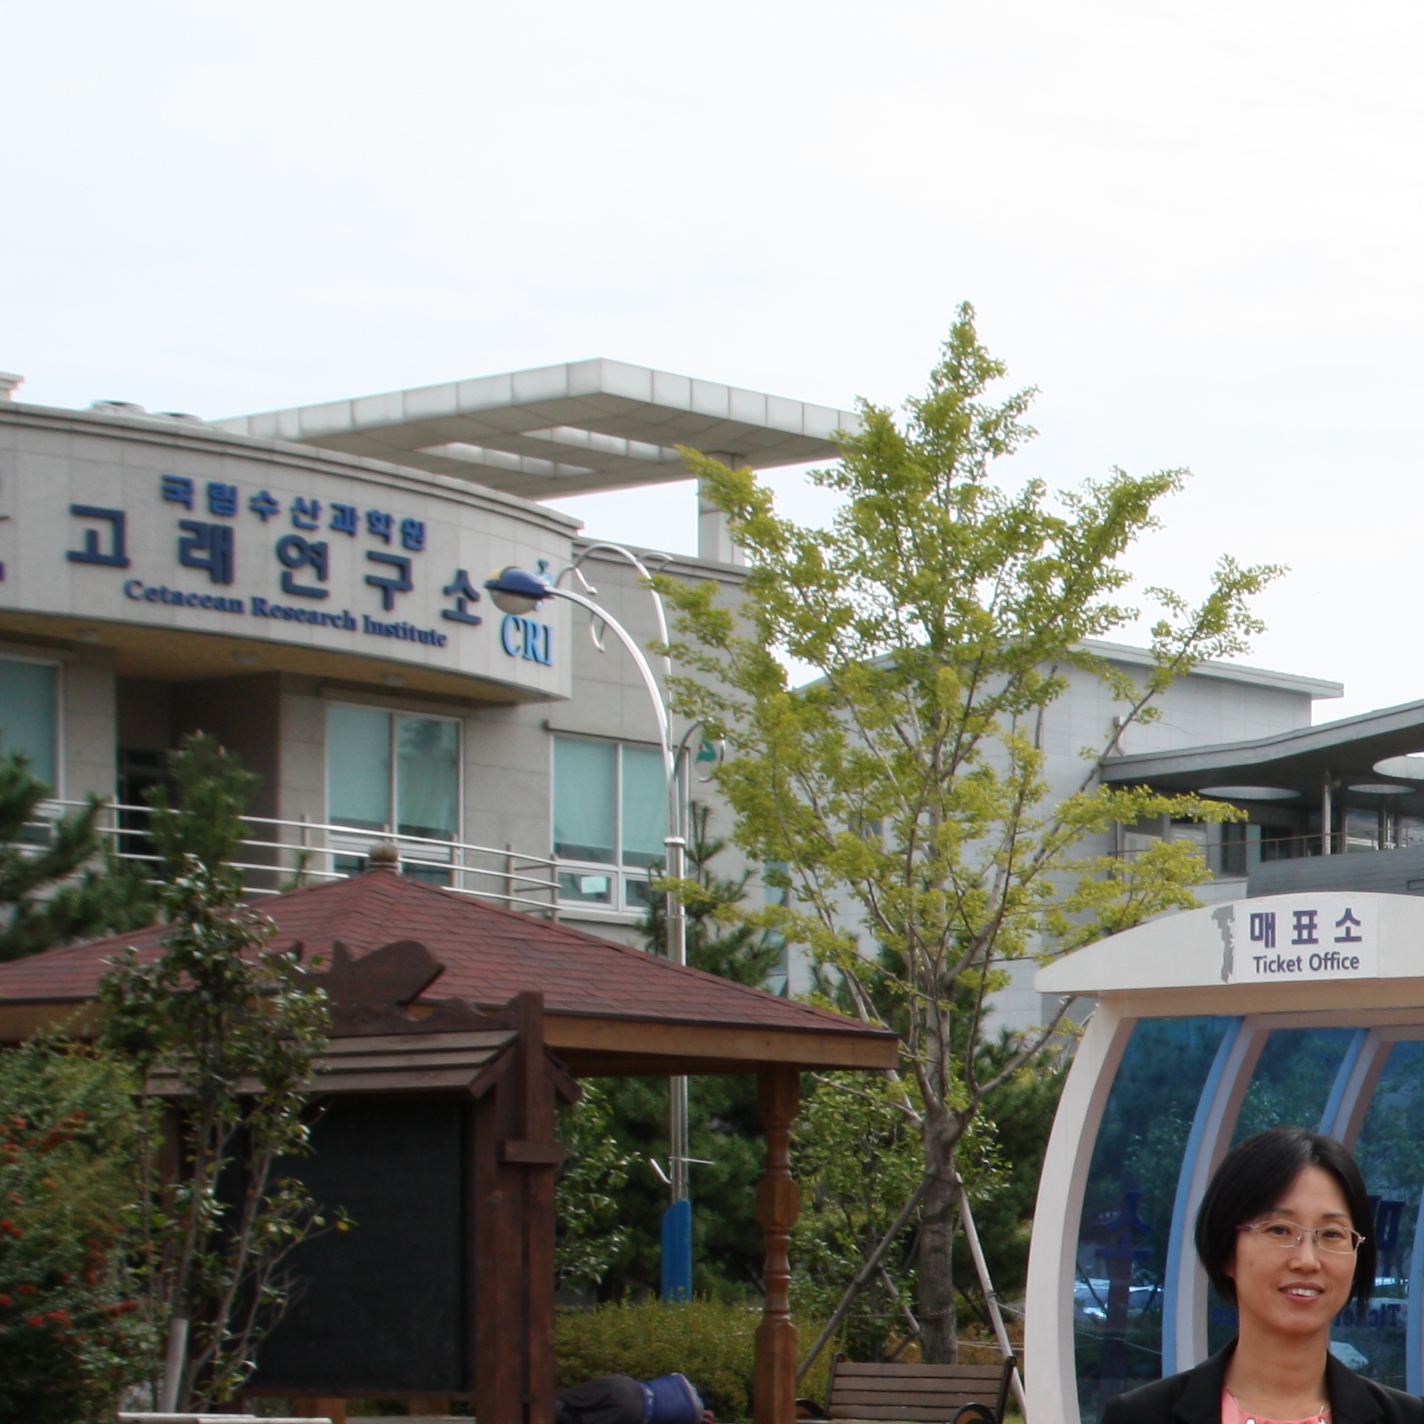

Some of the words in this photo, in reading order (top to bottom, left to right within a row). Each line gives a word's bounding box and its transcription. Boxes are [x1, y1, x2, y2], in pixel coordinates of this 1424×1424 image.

[161, 474, 426, 551] 국립수산과학원
[66, 503, 482, 626] 고래연구소
[124, 577, 245, 615] Cetacean
[251, 596, 357, 631] Research
[362, 614, 447, 648] Institute
[502, 614, 554, 666] CRI
[1250, 907, 1362, 948] 매표소
[1253, 954, 1303, 974] Ticket
[1309, 951, 1360, 972] Office
